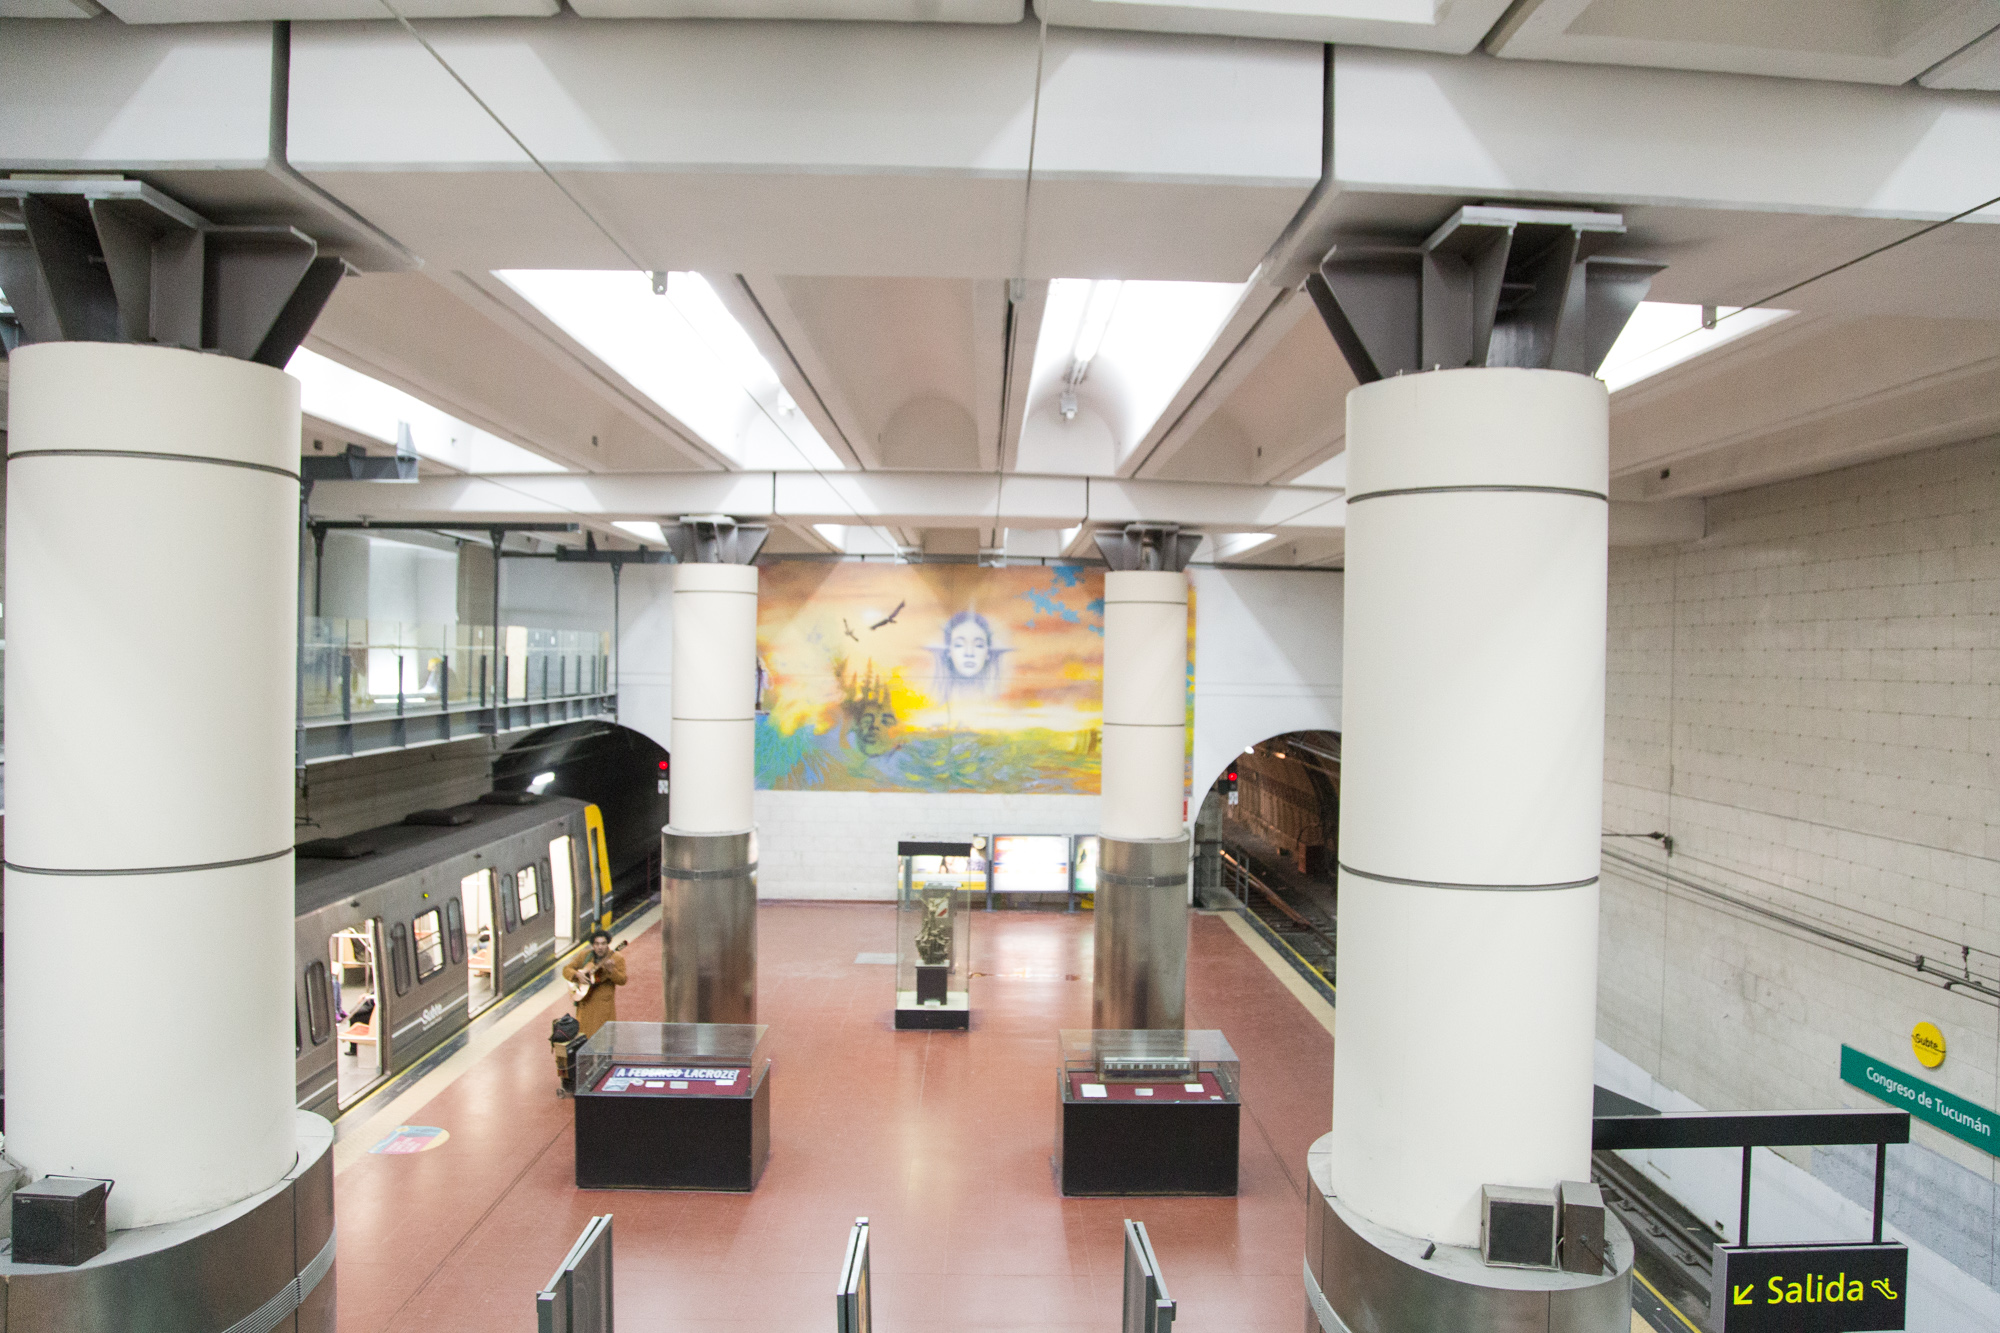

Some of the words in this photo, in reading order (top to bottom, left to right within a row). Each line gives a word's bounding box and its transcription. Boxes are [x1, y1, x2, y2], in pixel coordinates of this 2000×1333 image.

[1914, 1033, 1940, 1050] Subte
[616, 1067, 626, 1077] A
[684, 1069, 734, 1080] LACROZE
[1866, 1066, 1916, 1100] Congreso
[1917, 1091, 1933, 1109] de
[1934, 1097, 1991, 1137] Tucumán
[1767, 1272, 1864, 1305] Salida
